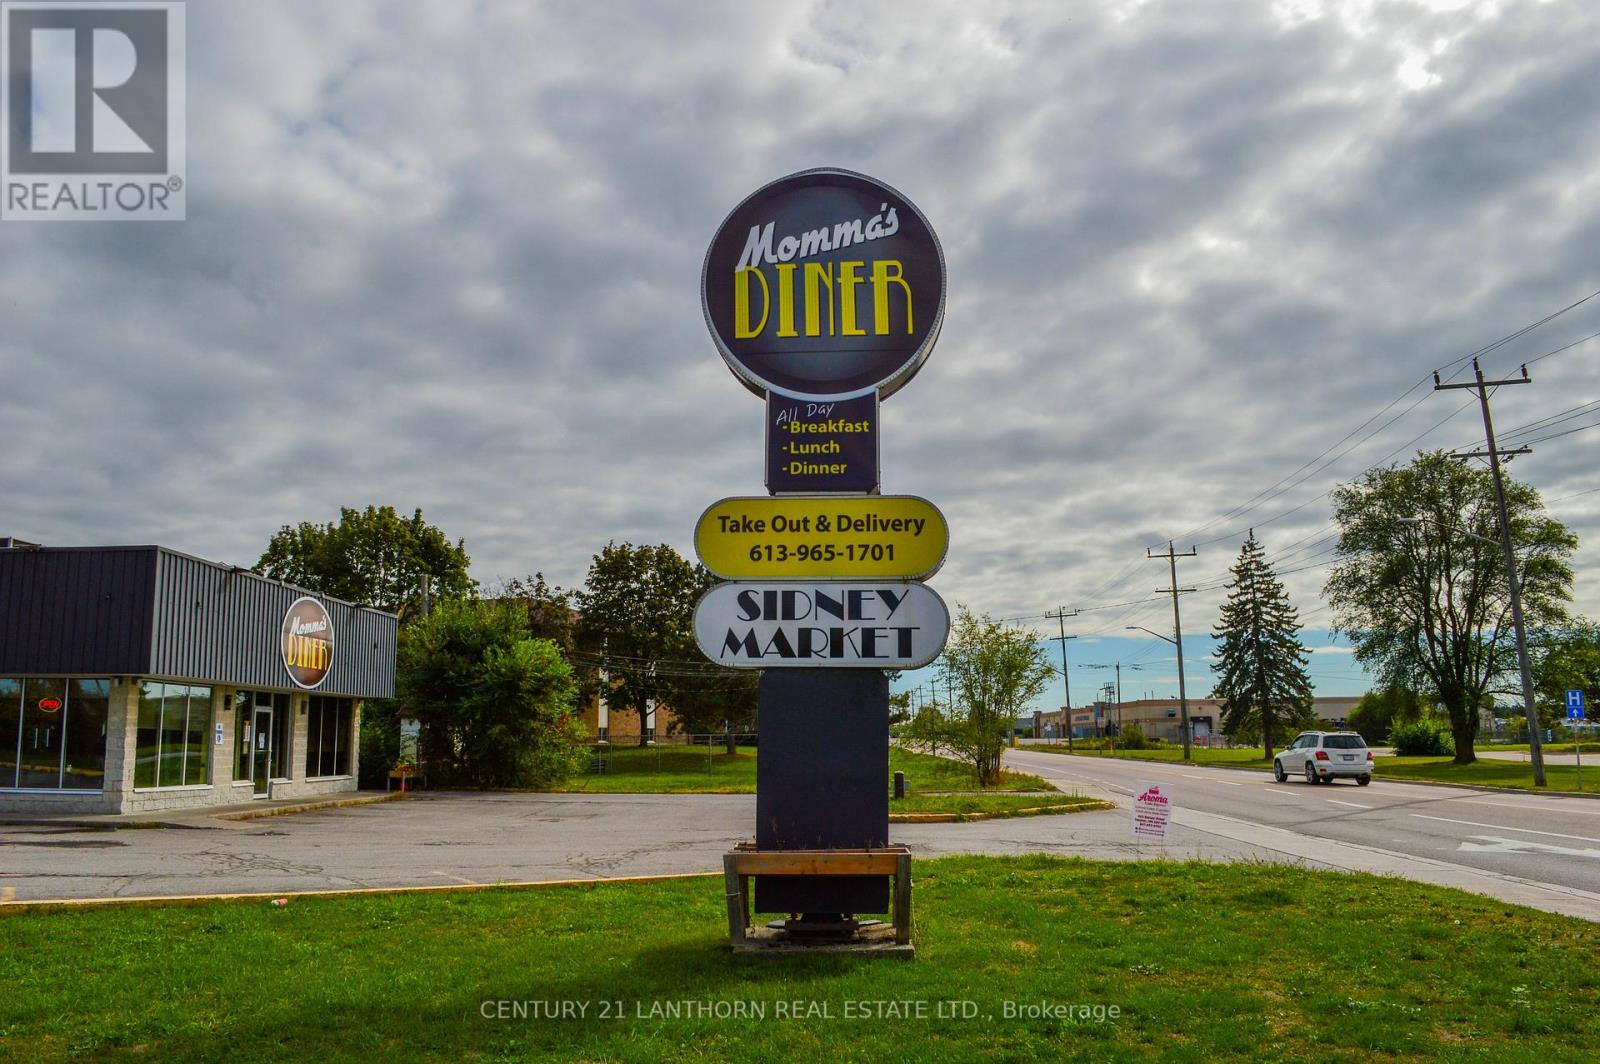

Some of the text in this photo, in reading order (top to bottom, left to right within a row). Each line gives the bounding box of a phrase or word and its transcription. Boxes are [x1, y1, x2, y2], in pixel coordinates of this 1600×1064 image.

[735, 202, 900, 273] Momma's
[734, 260, 914, 339] DINER
[776, 402, 835, 426] All Day
[718, 513, 926, 536] Take Out & Delivery
[749, 543, 895, 562] 613-965-1701
[736, 589, 910, 622] SIDNEY
[287, 632, 328, 671] DINER
[720, 626, 921, 659] MARKET
[1568, 691, 1581, 706] H
